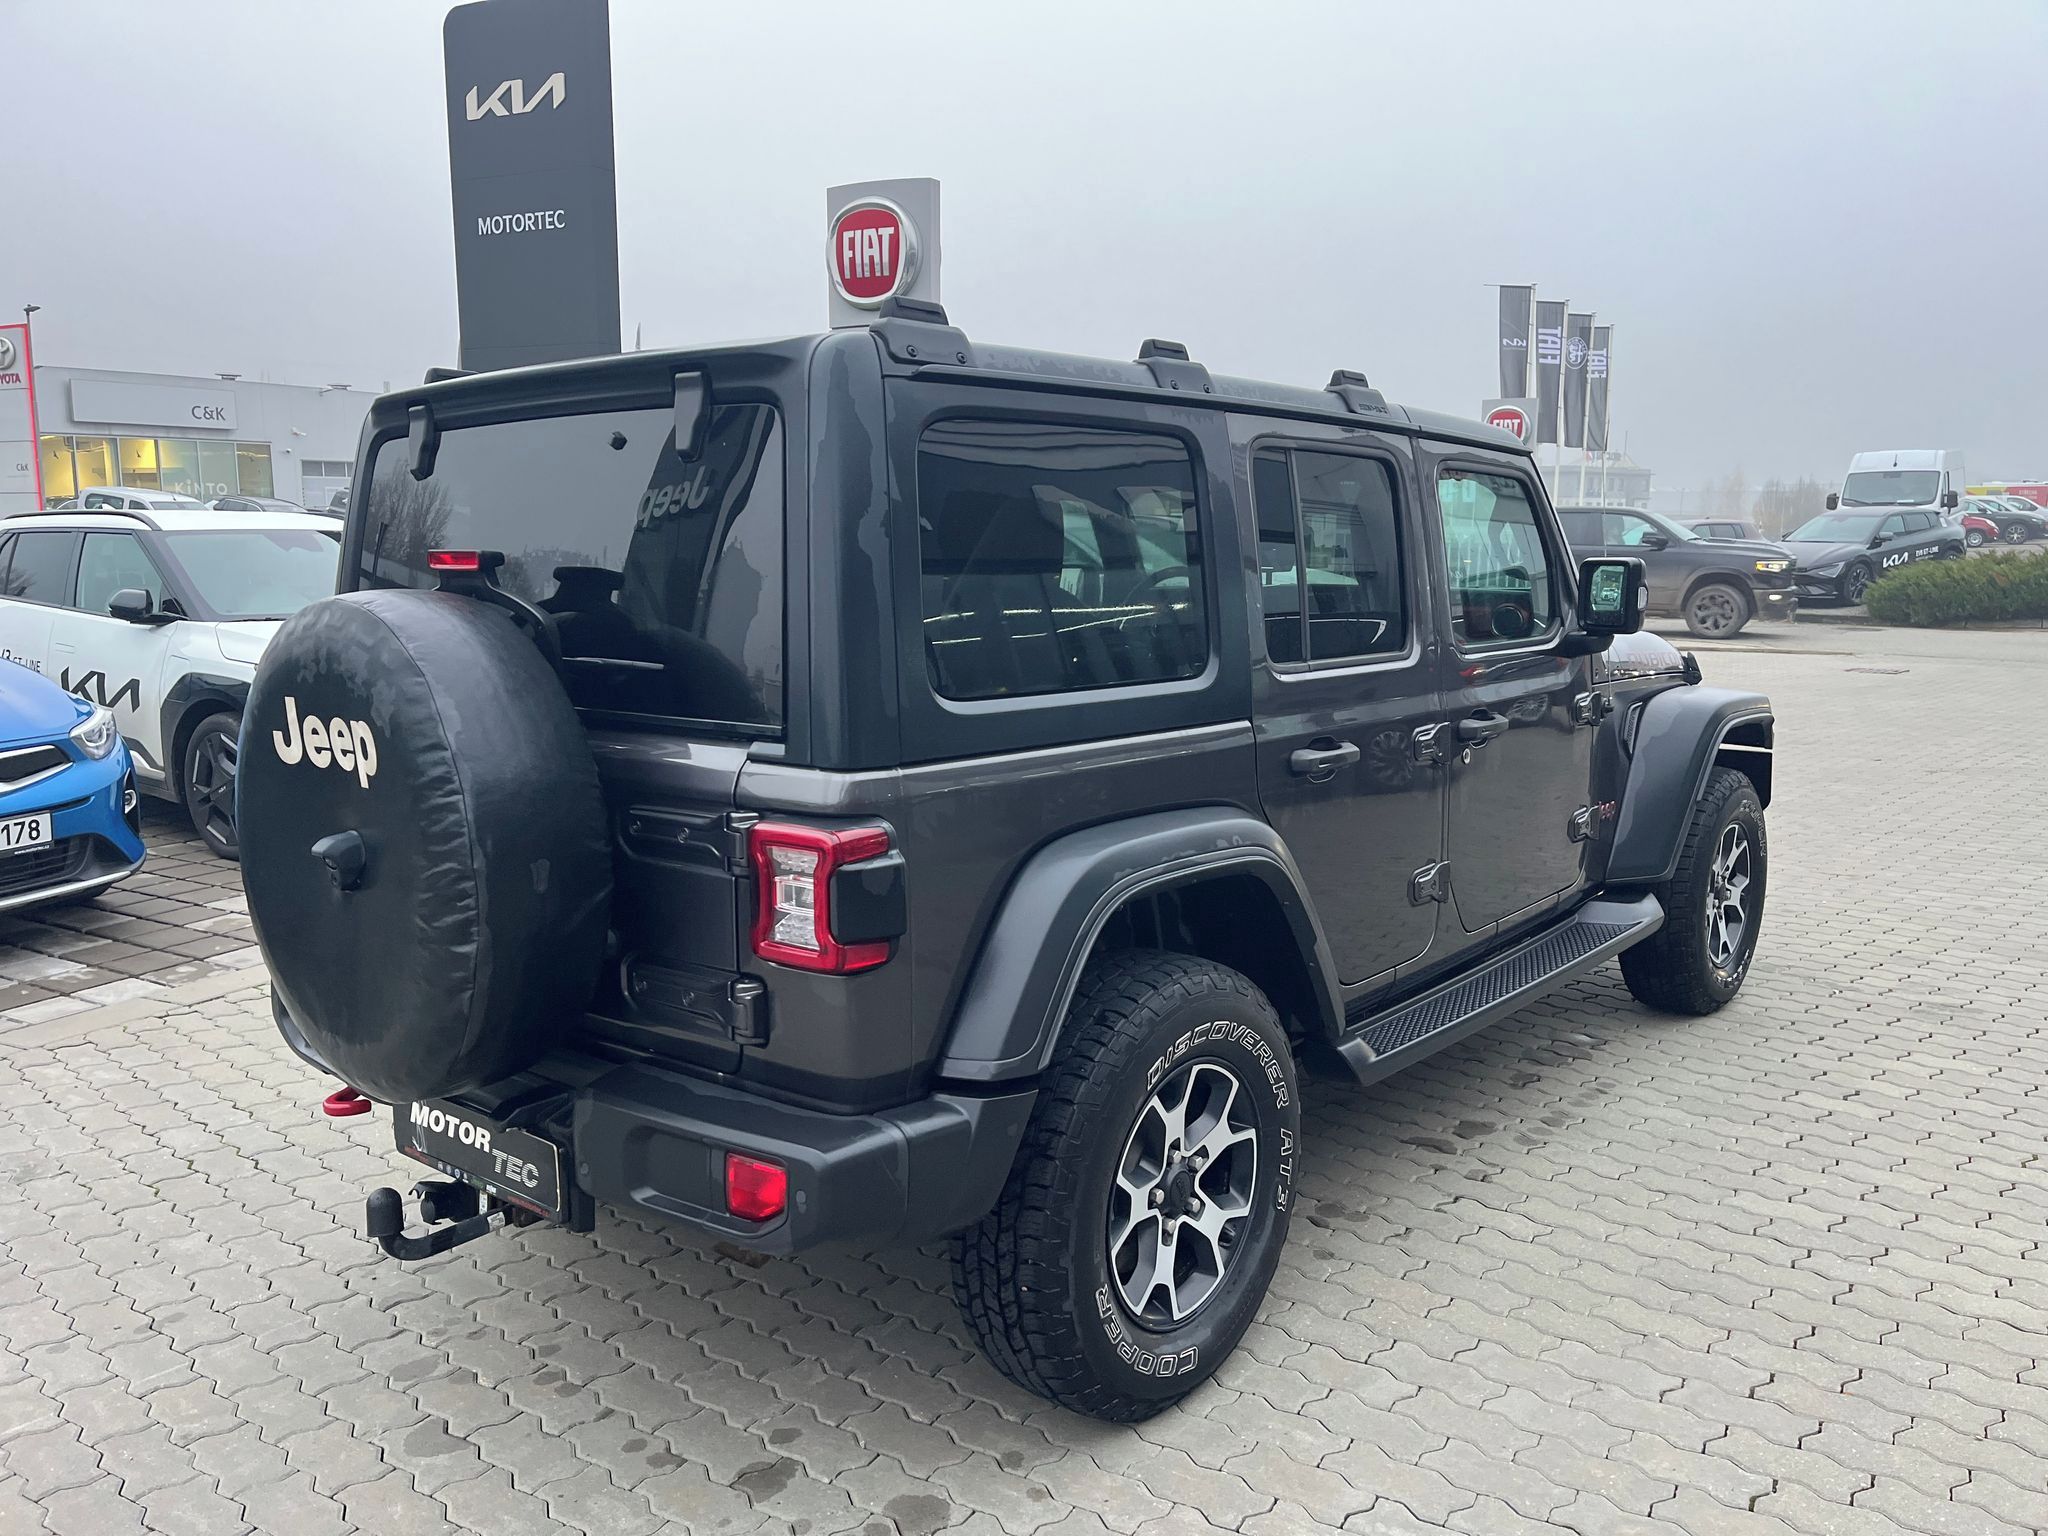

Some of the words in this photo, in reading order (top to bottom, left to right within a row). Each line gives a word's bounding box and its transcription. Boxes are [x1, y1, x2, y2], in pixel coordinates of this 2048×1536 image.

[465, 72, 566, 121] KIA
[477, 210, 566, 236] MOTORTEC
[843, 226, 895, 280] FIAT
[191, 405, 226, 421] C&K
[1882, 551, 1909, 569] KIA
[61, 666, 140, 713] KIA
[272, 696, 378, 789] Jeep
[0, 819, 41, 846] 178
[1146, 1020, 1290, 1110] DISCOVERER
[410, 1100, 491, 1153] MOTOR
[491, 1148, 540, 1189] TEC
[1094, 1281, 1200, 1378] COOPER
